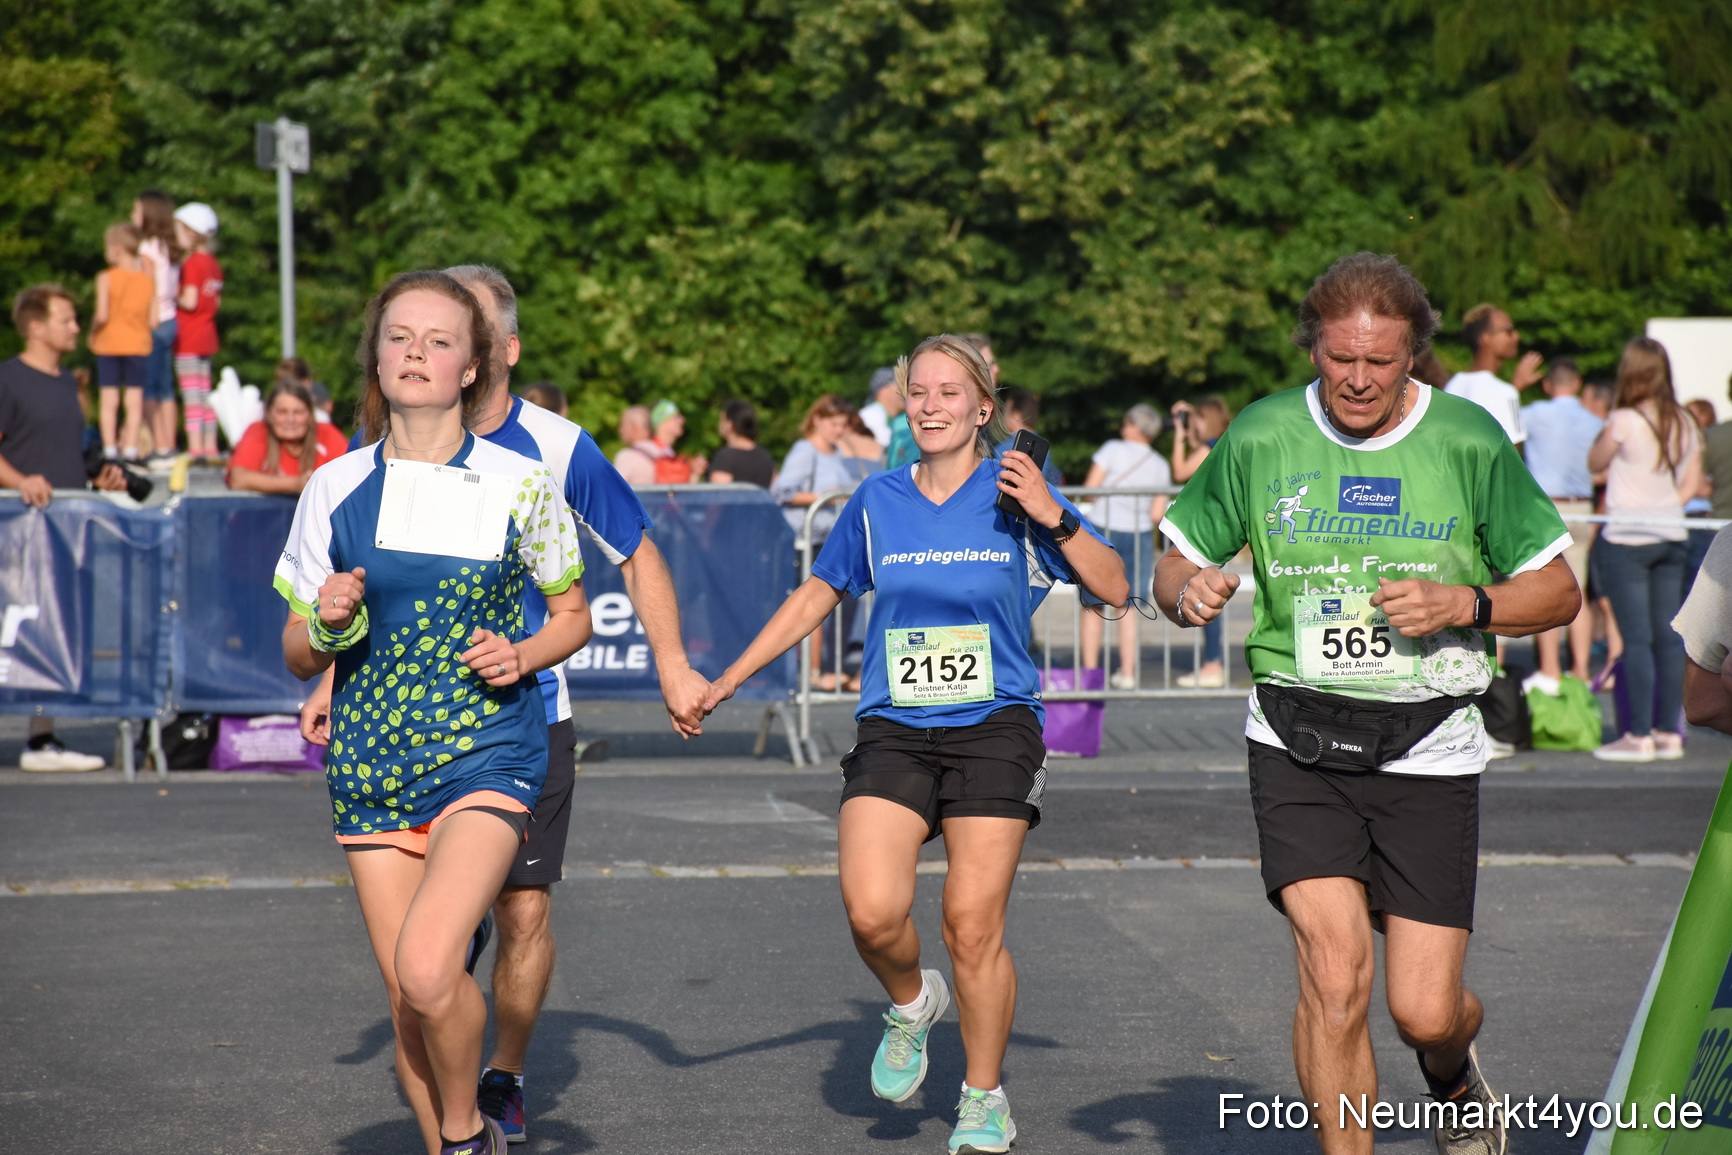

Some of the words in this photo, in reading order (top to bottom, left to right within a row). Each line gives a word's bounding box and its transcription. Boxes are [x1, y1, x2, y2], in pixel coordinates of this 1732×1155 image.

[1267, 479, 1282, 495] 10
[1352, 492, 1397, 503] Fischer
[1306, 508, 1459, 541] firmenlauf
[1306, 535, 1371, 545] neumarkt
[881, 548, 1011, 566] energiegeladen
[1268, 555, 1352, 578] Gesunde
[1362, 555, 1437, 573] Firmen
[1304, 577, 1367, 596] laufen
[1313, 611, 1360, 622] firmenlauf
[901, 642, 940, 652] firmenlauf
[1322, 626, 1392, 660] 565
[964, 645, 984, 653] 2019
[899, 654, 978, 684] 2152
[1332, 661, 1352, 669] Bott
[1354, 660, 1383, 668] Armin
[913, 684, 945, 693] Foistner
[947, 682, 968, 693] Katja
[1340, 744, 1363, 753] DEKRA
